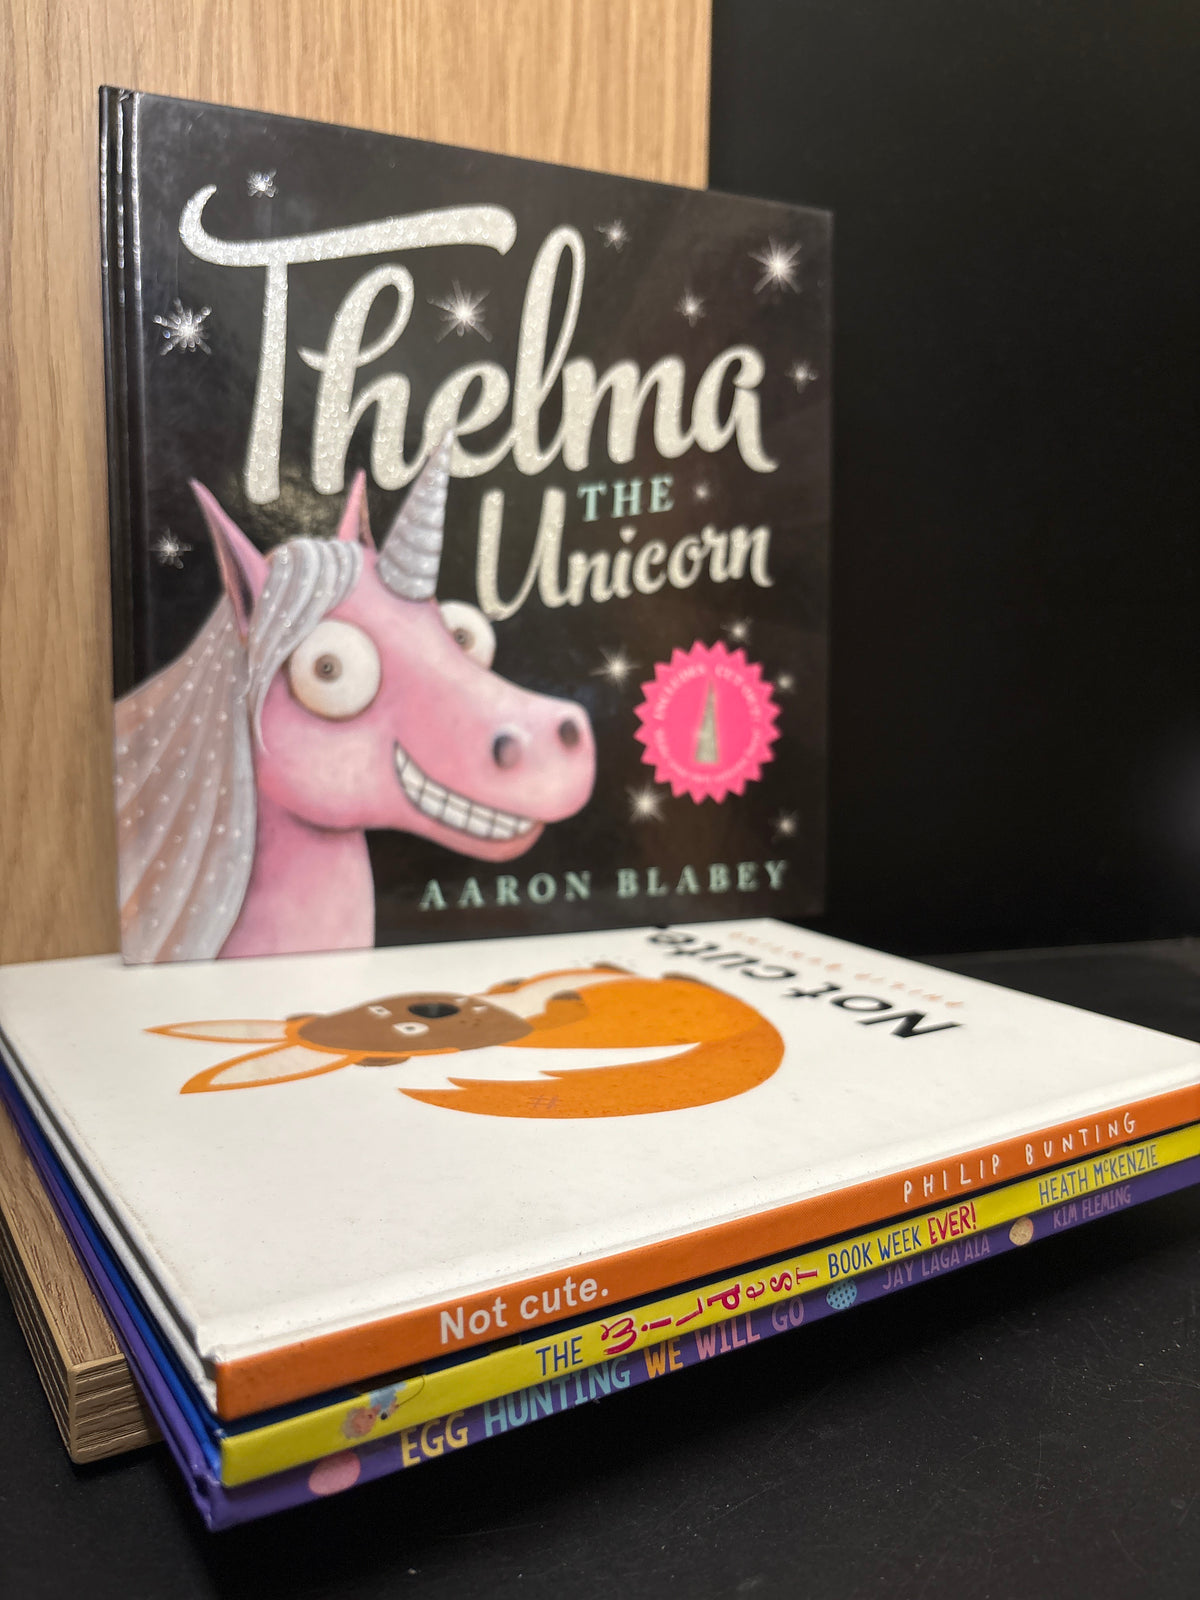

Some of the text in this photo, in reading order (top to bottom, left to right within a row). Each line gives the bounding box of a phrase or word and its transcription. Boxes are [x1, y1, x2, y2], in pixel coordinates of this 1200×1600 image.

[179, 185, 779, 504] Thelma
[577, 476, 674, 522] THE
[476, 489, 773, 621] Unicorn
[419, 859, 788, 911] AARON BLABEY
[904, 1112, 1137, 1204] PHILIP BUNTING
[1038, 1166, 1089, 1205] HEATH
[1053, 1184, 1132, 1230] KIM FLEMING
[439, 1275, 609, 1344] Not cute.
[535, 1336, 583, 1376] THE
[828, 1242, 873, 1278] BOOK
[877, 1225, 922, 1261] WEEK
[927, 1201, 977, 1245] EVER!
[882, 1260, 914, 1290] JAY
[400, 1298, 805, 1468] EGG HUNTING WE WILL GO
